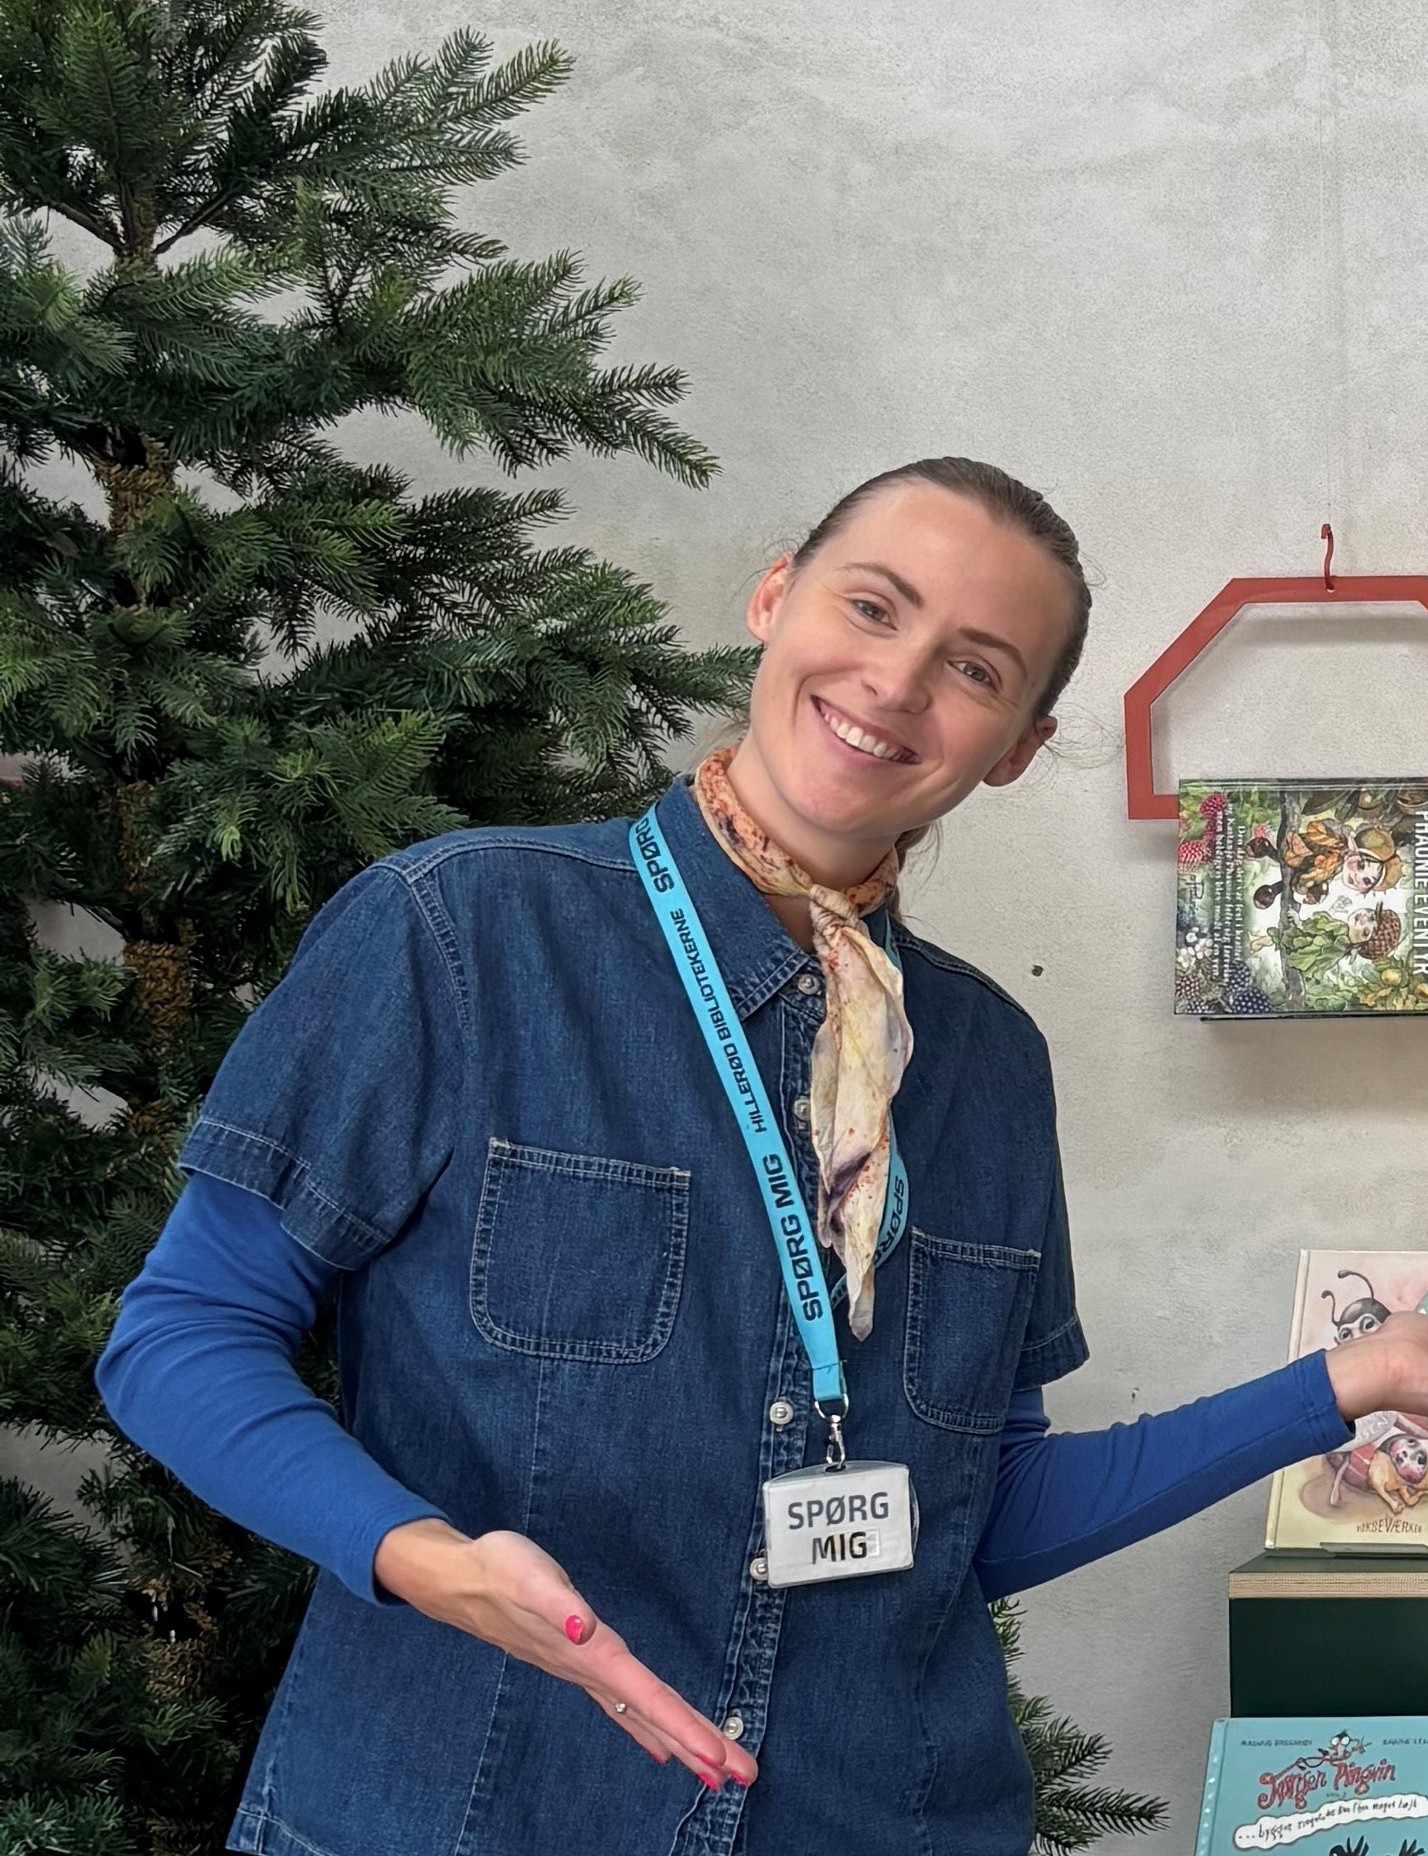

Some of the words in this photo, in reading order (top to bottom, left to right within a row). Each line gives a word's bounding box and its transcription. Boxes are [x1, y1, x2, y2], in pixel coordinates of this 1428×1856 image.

[669, 909, 730, 1043] BIBLIOTEKERNE
[723, 1044, 767, 1133] HILLERØD
[762, 1153, 799, 1210] MIG
[780, 1214, 824, 1322] SPØRG
[788, 1492, 889, 1530] SPØRG
[812, 1531, 867, 1565] MIG
